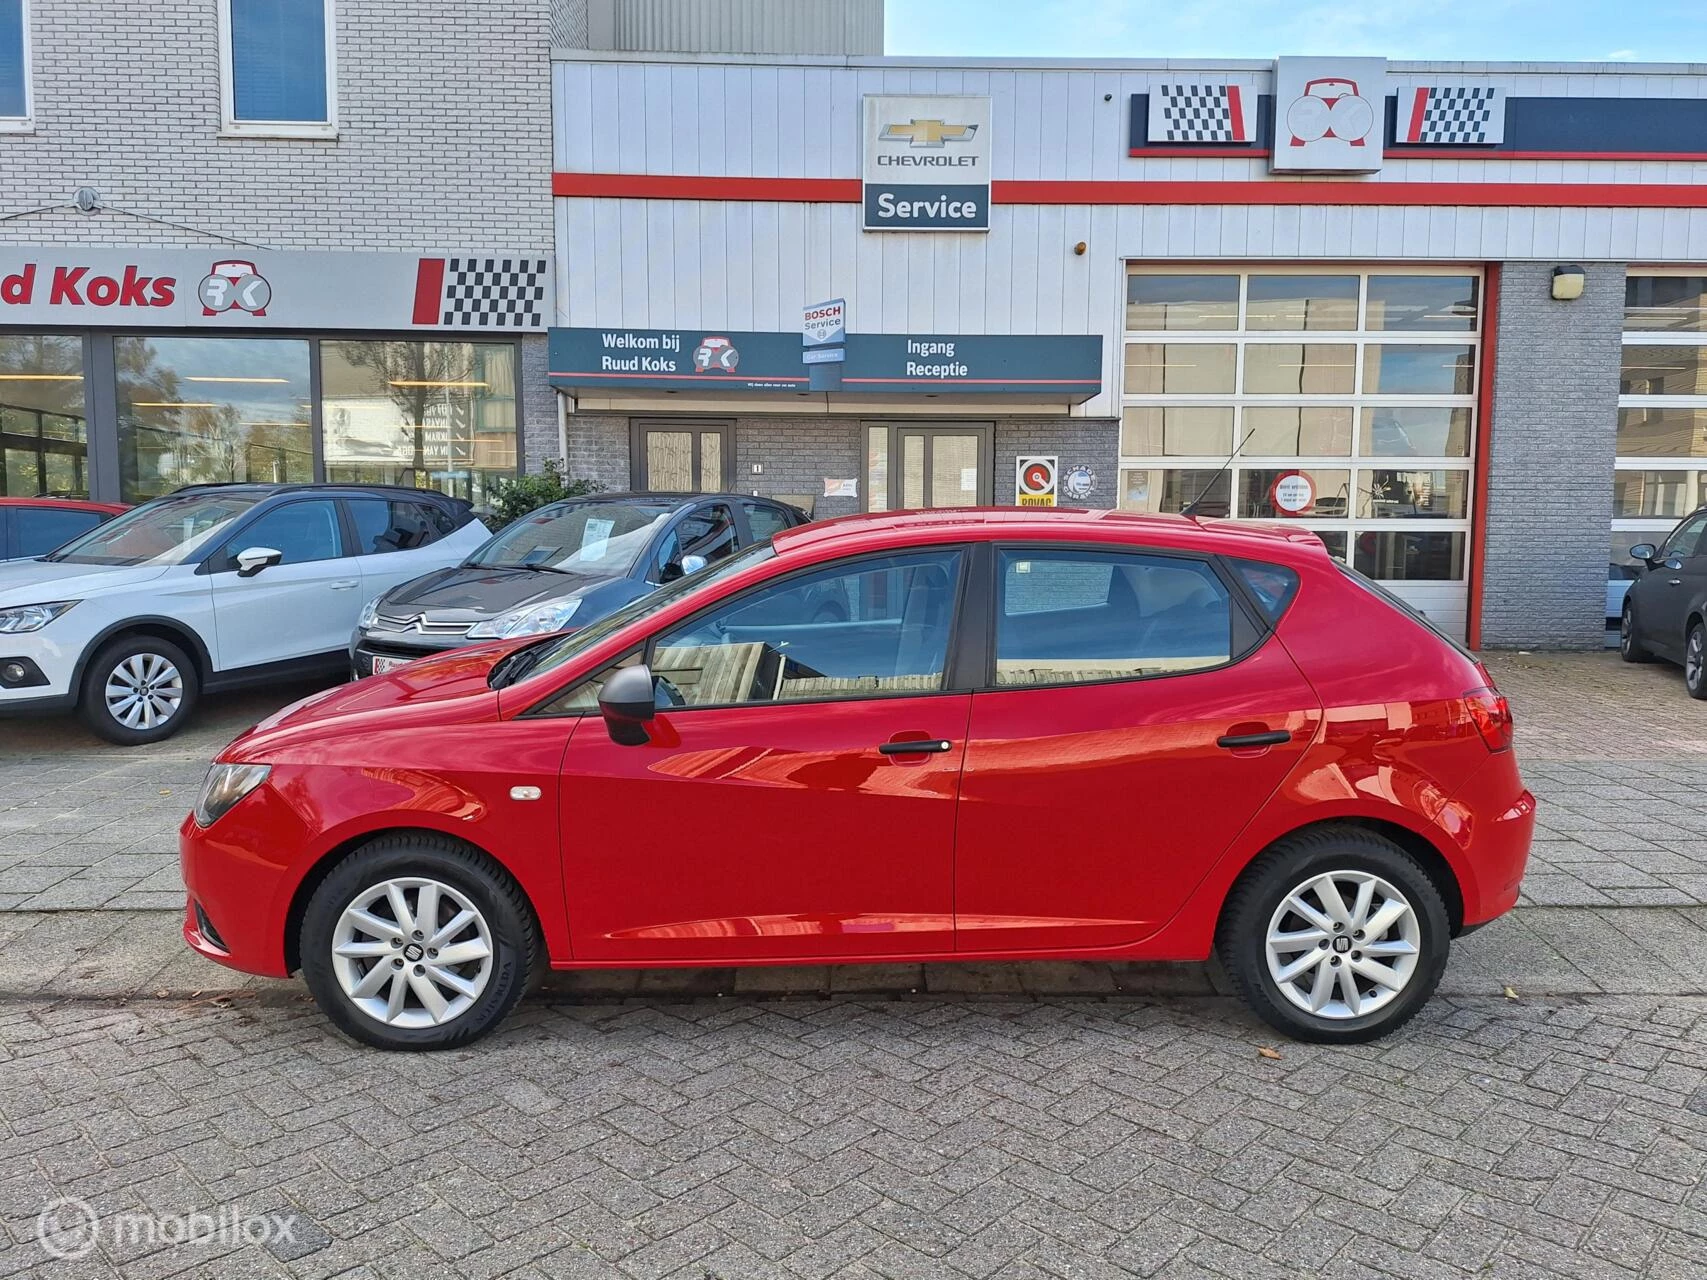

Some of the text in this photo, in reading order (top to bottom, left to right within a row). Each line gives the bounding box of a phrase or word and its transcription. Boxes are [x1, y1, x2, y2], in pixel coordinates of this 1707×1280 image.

[877, 155, 979, 167] CHEVROLET
[878, 193, 977, 218] Service
[49, 265, 177, 307] Koks
[804, 306, 841, 321] BOSCH
[804, 318, 841, 331] Service
[602, 333, 680, 353] Welkom bij
[907, 339, 956, 358] Ingang
[602, 356, 677, 372] Ruud Koks
[906, 361, 969, 379] Receptie
